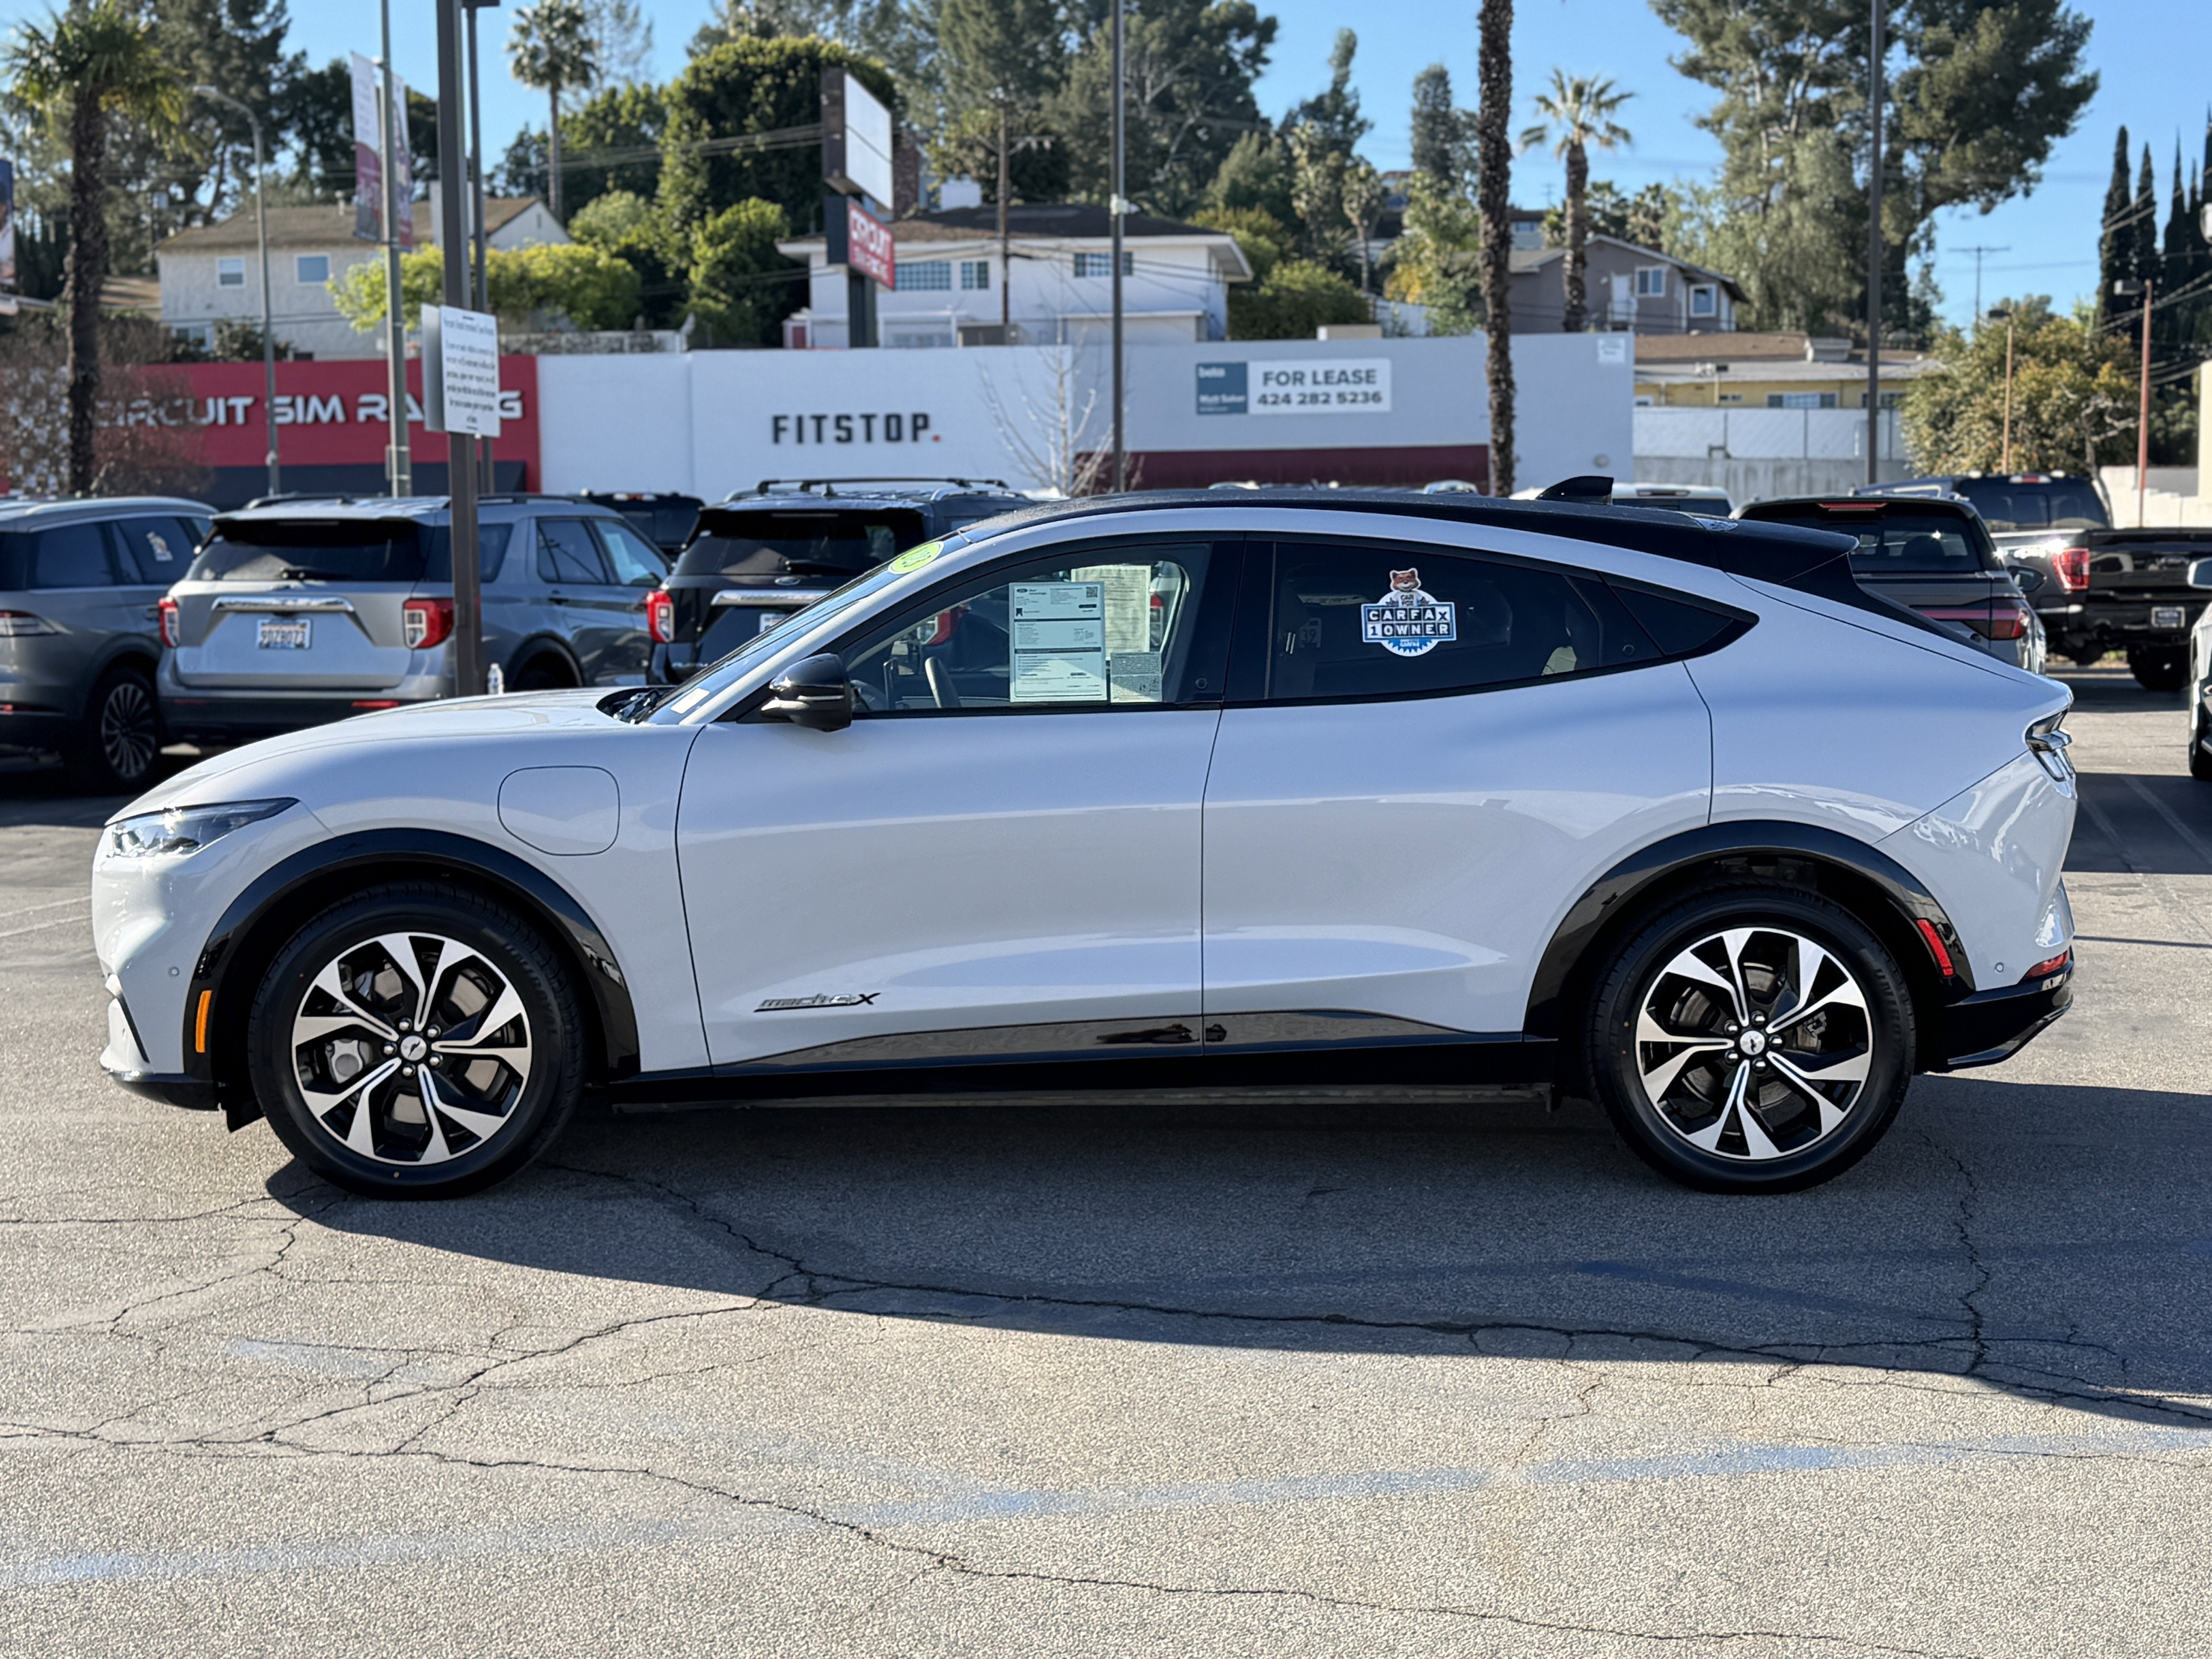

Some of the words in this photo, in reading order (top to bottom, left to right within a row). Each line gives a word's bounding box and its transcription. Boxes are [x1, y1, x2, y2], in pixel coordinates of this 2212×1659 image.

[1262, 371, 1305, 386] FOR
[1312, 368, 1377, 385] LEASE
[1257, 393, 1292, 405] 424
[1297, 392, 1330, 405] 282
[1337, 391, 1382, 404] 5236
[273, 394, 346, 424] SIM
[1369, 608, 1447, 620] CARFAX
[1371, 625, 1377, 635] 1
[1384, 624, 1448, 635] OWNER
